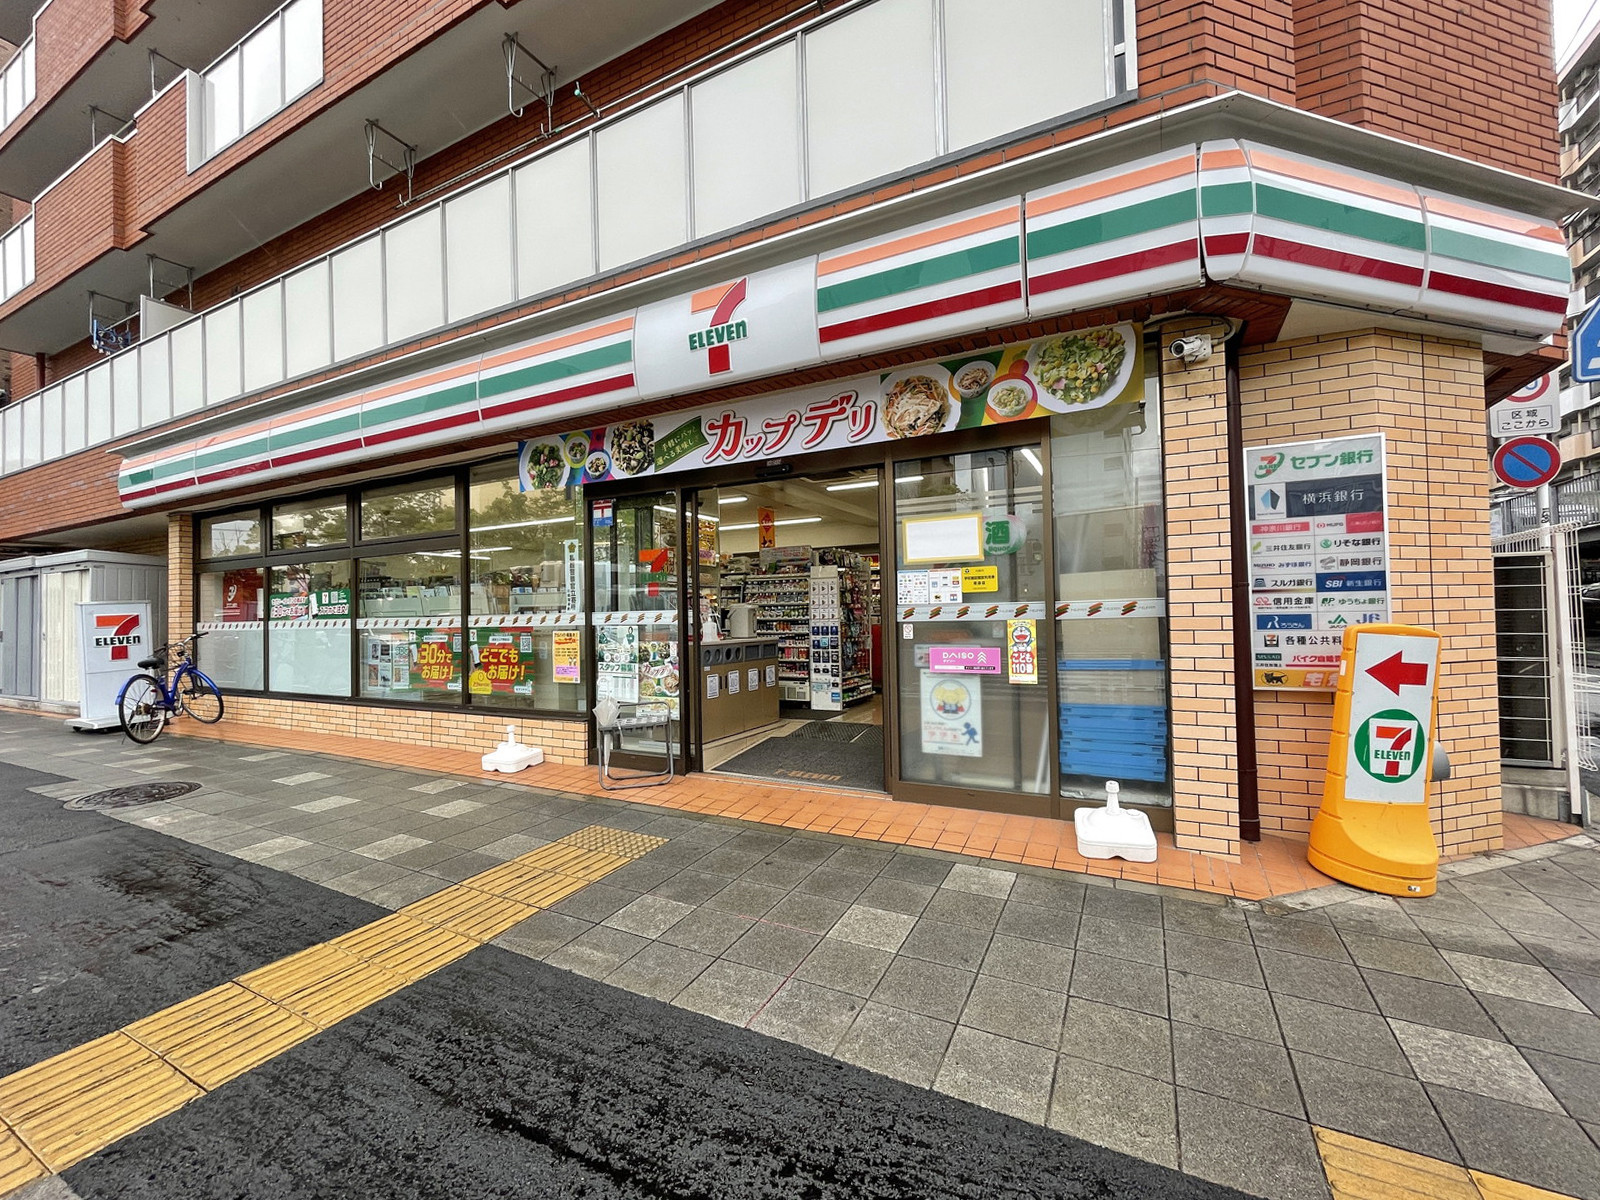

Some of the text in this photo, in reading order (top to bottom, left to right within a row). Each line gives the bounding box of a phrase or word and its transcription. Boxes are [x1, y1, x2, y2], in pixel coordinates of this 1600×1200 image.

[1511, 409, 1538, 419] 区域
[703, 393, 874, 460] カップデリ
[1501, 418, 1549, 430] ここから
[1290, 449, 1374, 470] セブン銀行
[1302, 489, 1364, 505] 横浜銀行
[1260, 523, 1301, 533] 神奈川銀行
[1265, 543, 1311, 552] 三井住友銀行
[1334, 537, 1381, 548] りそな銀行
[1340, 557, 1382, 566] 静岡銀行
[1271, 578, 1313, 587] スルガ銀行
[1325, 580, 1343, 588] SBI
[1273, 597, 1314, 605] 信用金庫
[1339, 597, 1385, 605] ゆうちょ銀行
[480, 648, 519, 663] どこでも
[1012, 652, 1033, 663] こども
[421, 665, 454, 680] お届け!
[487, 665, 526, 680] お届け!
[599, 663, 636, 672] スタッフ募集!
